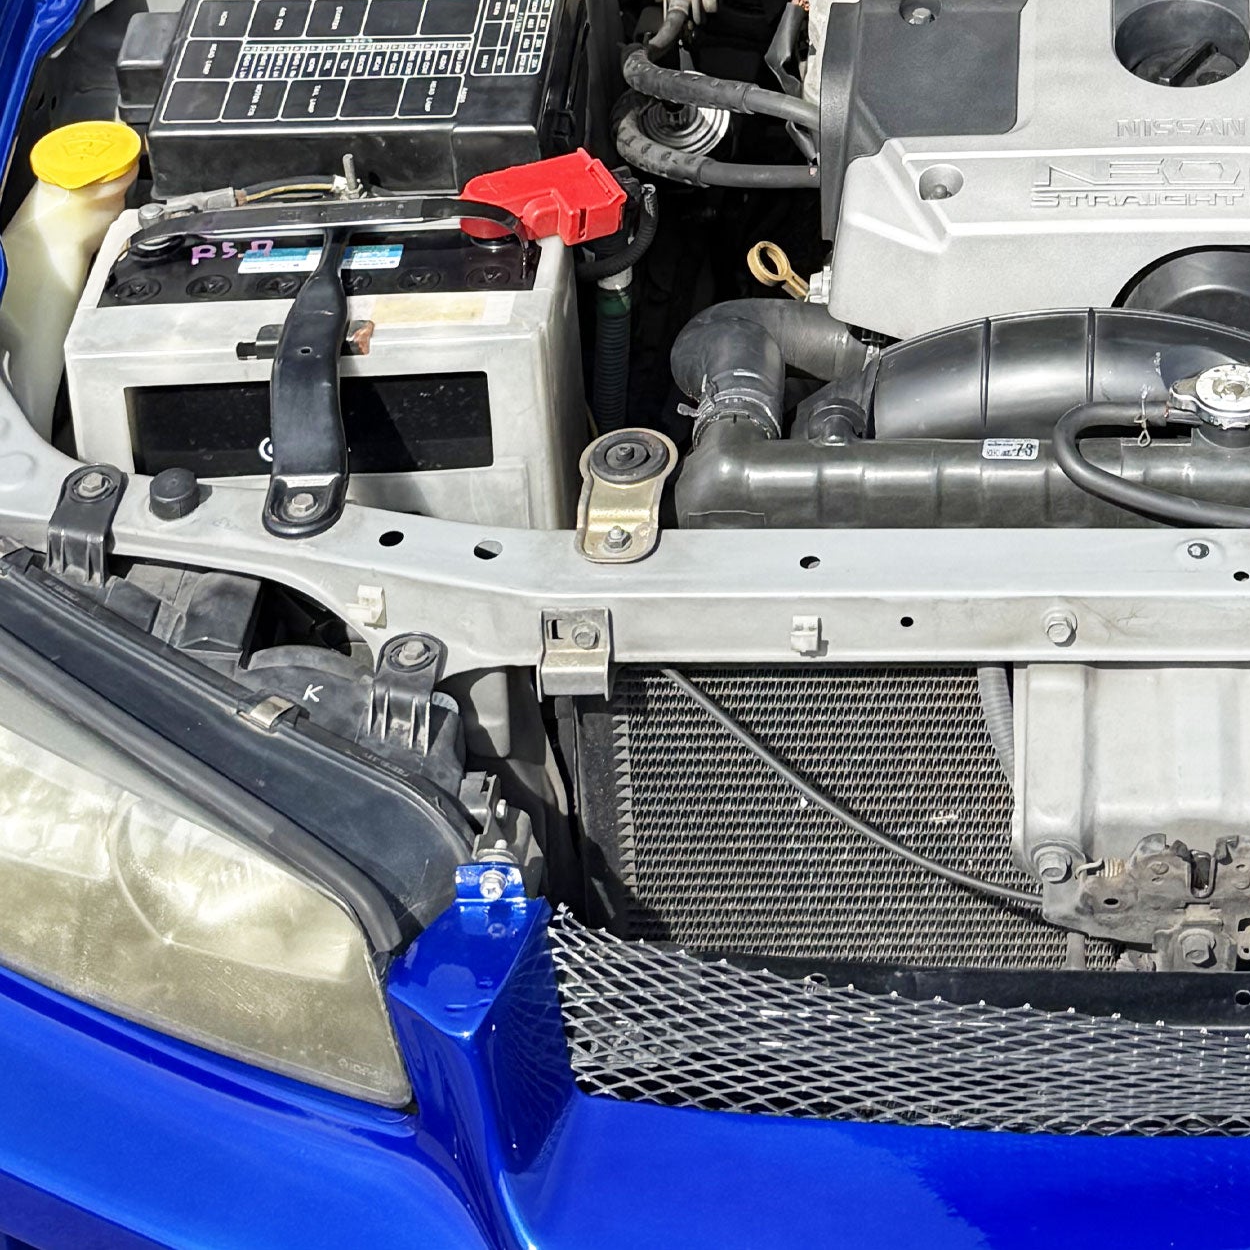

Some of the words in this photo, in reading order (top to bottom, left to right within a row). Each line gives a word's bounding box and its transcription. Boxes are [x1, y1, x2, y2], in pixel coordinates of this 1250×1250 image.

[1116, 117, 1247, 138] NISSAN
[1032, 158, 1242, 186] NEO
[1030, 192, 1245, 208] STRAIGHT
[302, 683, 324, 703] K
